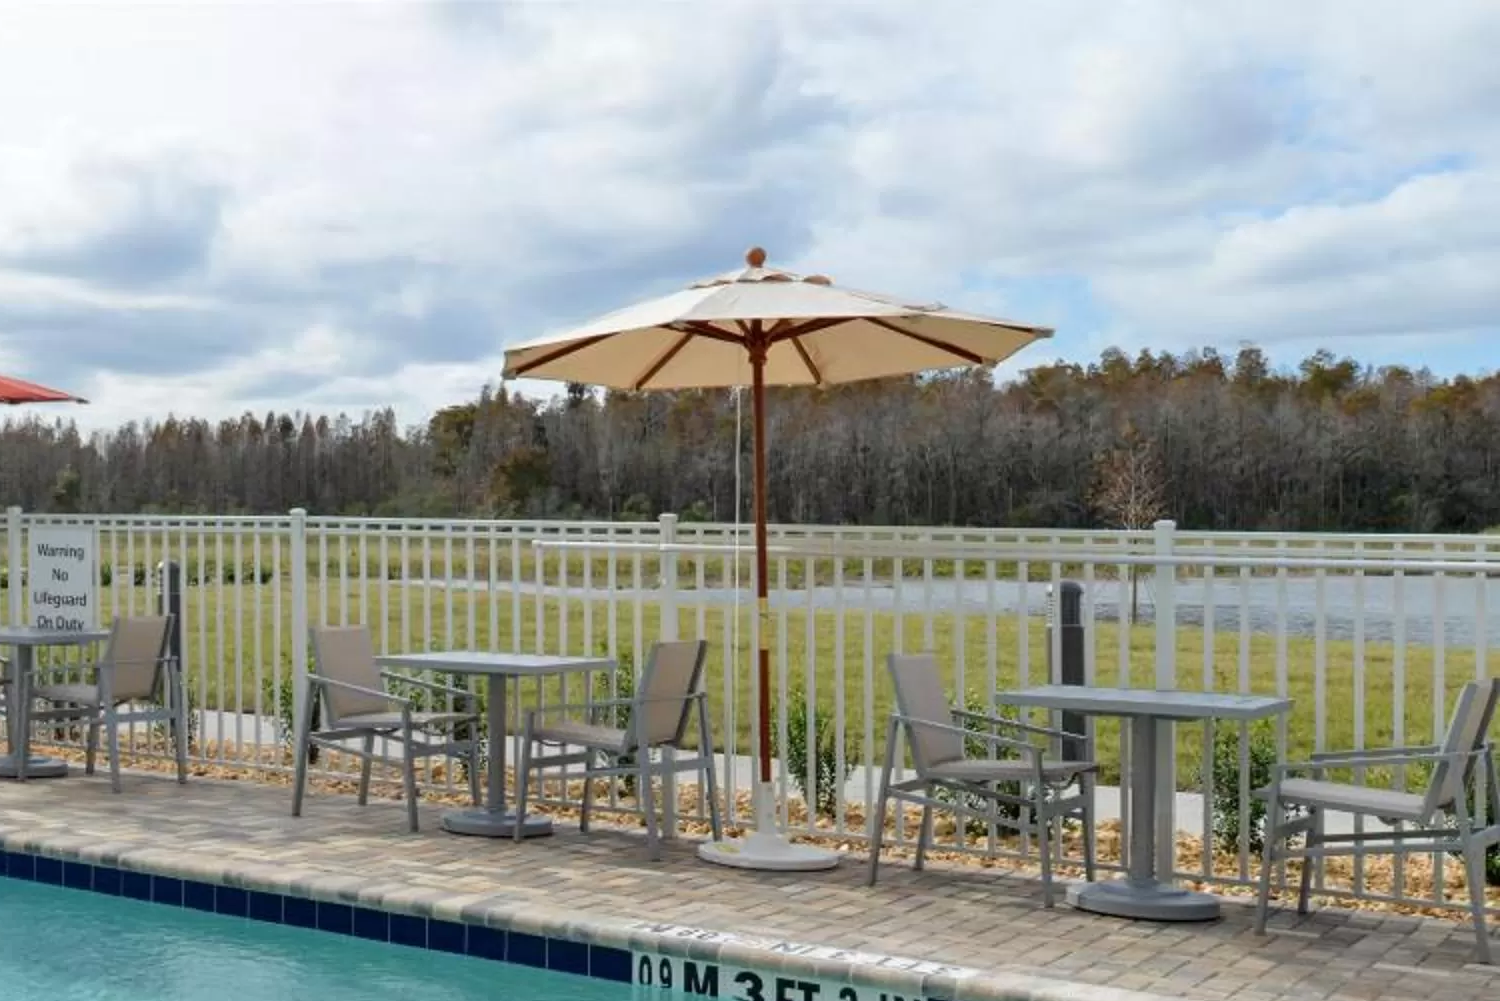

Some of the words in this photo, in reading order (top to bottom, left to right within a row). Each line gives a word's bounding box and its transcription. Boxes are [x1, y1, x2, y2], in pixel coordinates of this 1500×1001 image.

[37, 544, 84, 561] Warning
[52, 568, 69, 582] No
[34, 592, 87, 608] Lifeguard
[37, 615, 53, 629] On
[56, 615, 84, 631] Duty
[684, 961, 719, 997] M
